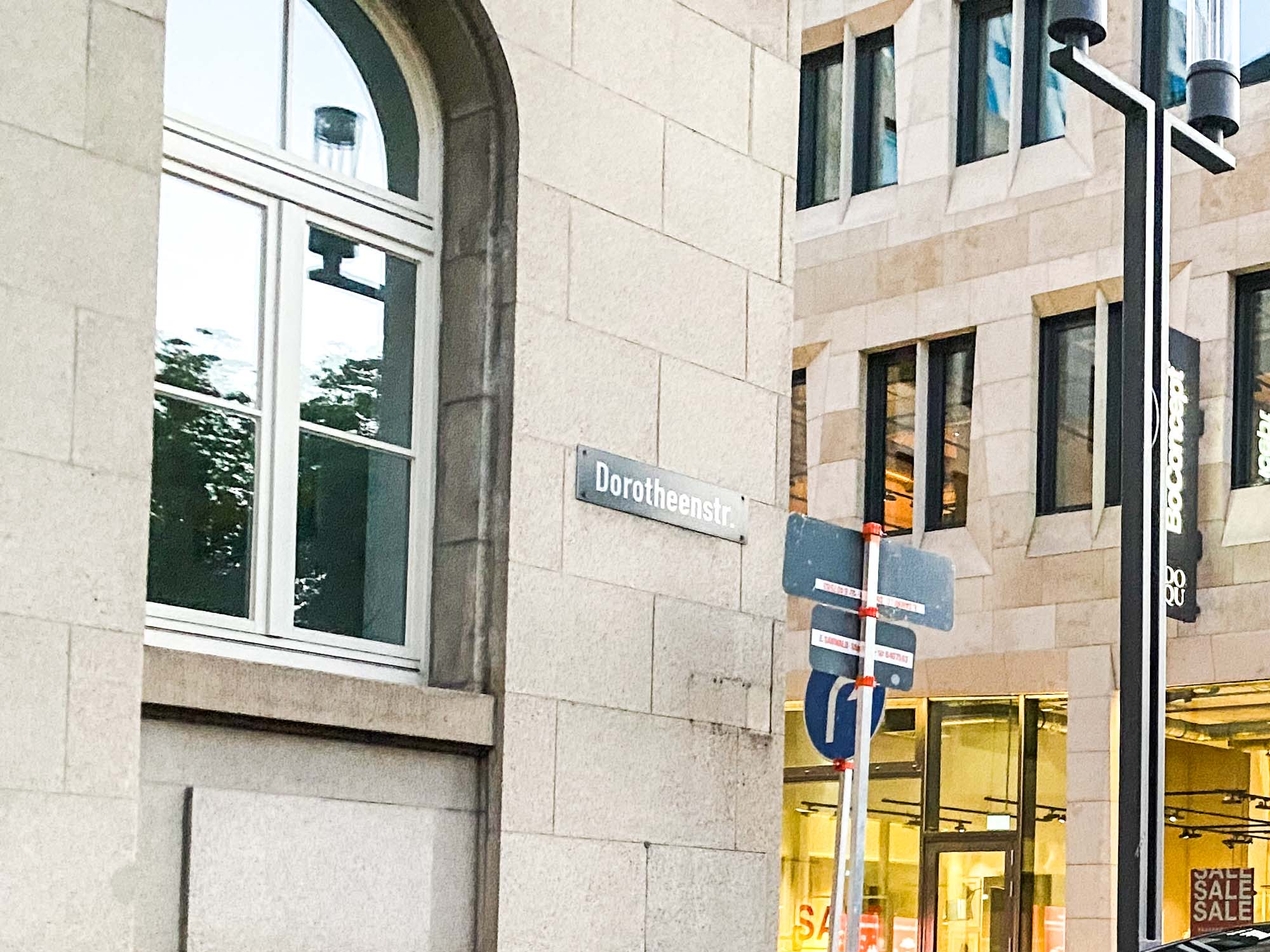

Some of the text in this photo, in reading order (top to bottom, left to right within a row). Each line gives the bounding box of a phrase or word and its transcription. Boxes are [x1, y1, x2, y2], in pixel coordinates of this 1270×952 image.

[1166, 365, 1188, 534] BoConcept
[595, 461, 736, 529] Dorotheenstr.
[1192, 900, 1252, 922] SALE
[1193, 879, 1252, 901] SALE
